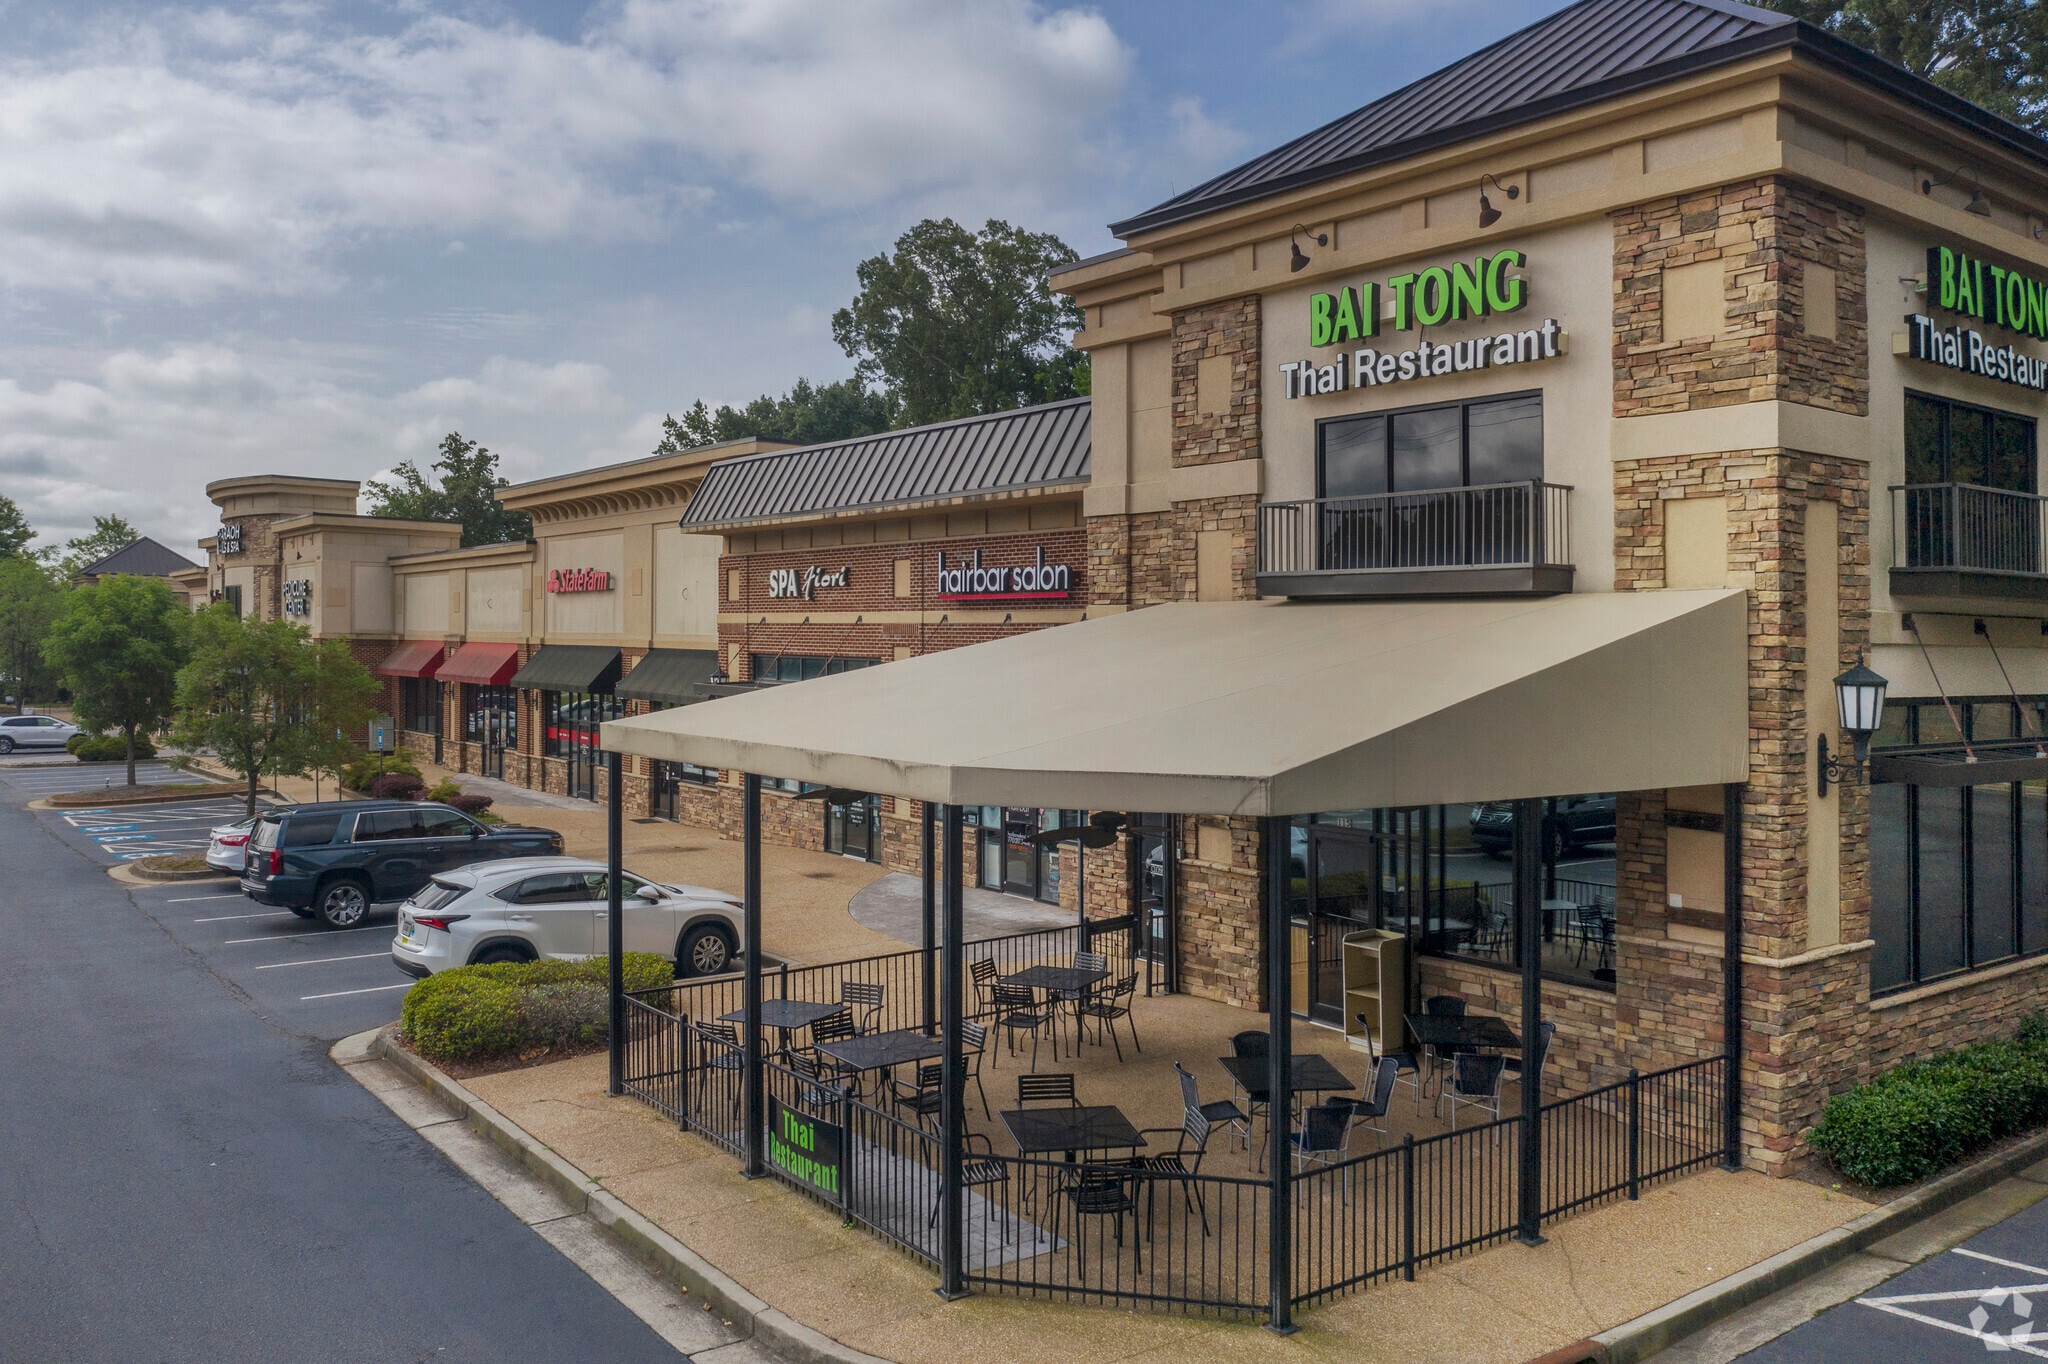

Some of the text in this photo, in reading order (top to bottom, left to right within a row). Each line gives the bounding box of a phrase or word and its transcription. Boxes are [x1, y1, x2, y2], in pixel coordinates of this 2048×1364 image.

[1311, 249, 1526, 347] BAI TONG
[1938, 246, 2048, 338] BAI TON
[1279, 318, 1558, 400] Thai Restaurant
[1912, 312, 1964, 369] Thai
[769, 569, 798, 598] SPA
[938, 545, 1069, 593] hairbar salon
[285, 598, 305, 616] CENTER
[782, 1109, 815, 1152] Thai
[770, 1130, 838, 1194] Restaurant
